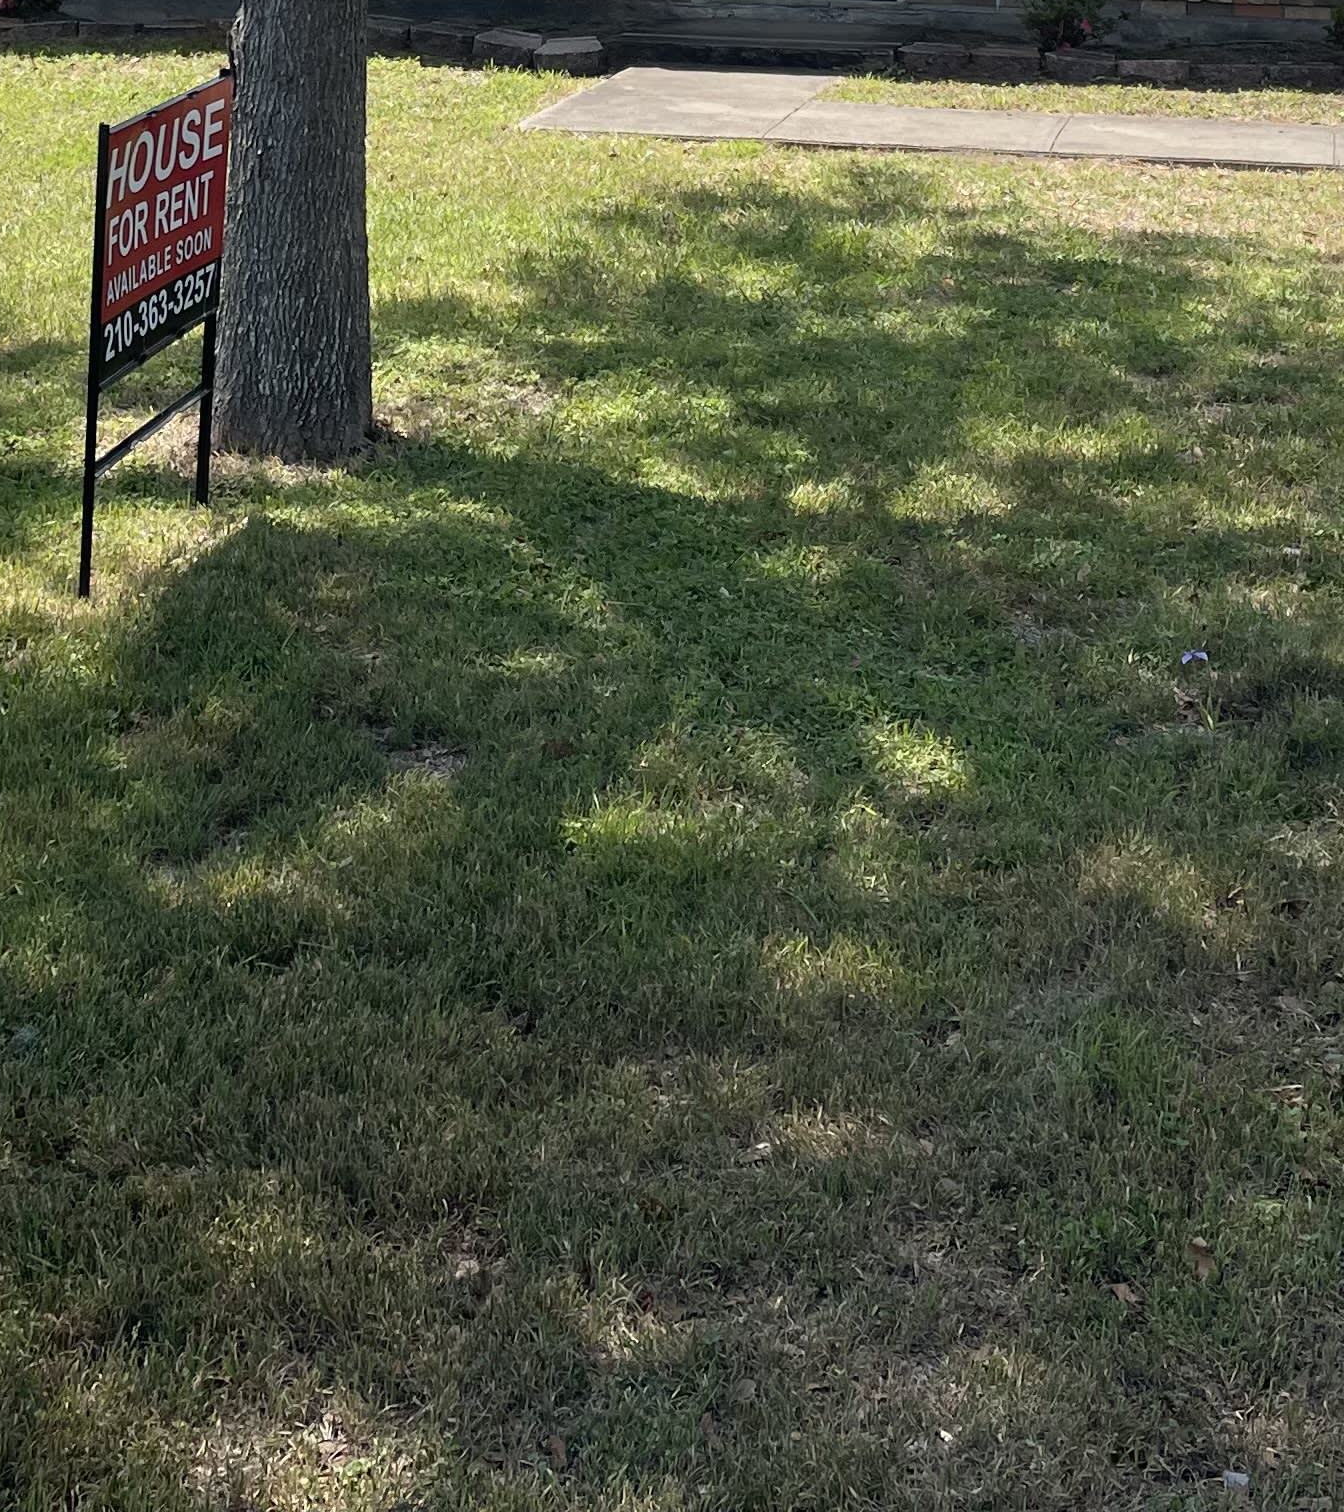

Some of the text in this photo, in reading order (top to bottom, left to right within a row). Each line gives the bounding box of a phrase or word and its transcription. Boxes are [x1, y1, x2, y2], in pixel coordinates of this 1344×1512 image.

[106, 98, 225, 209] HOUSE
[106, 226, 212, 307] AVAILABLE SOON
[108, 170, 214, 266] FOR RENT
[104, 262, 216, 362] 210-363-3257
